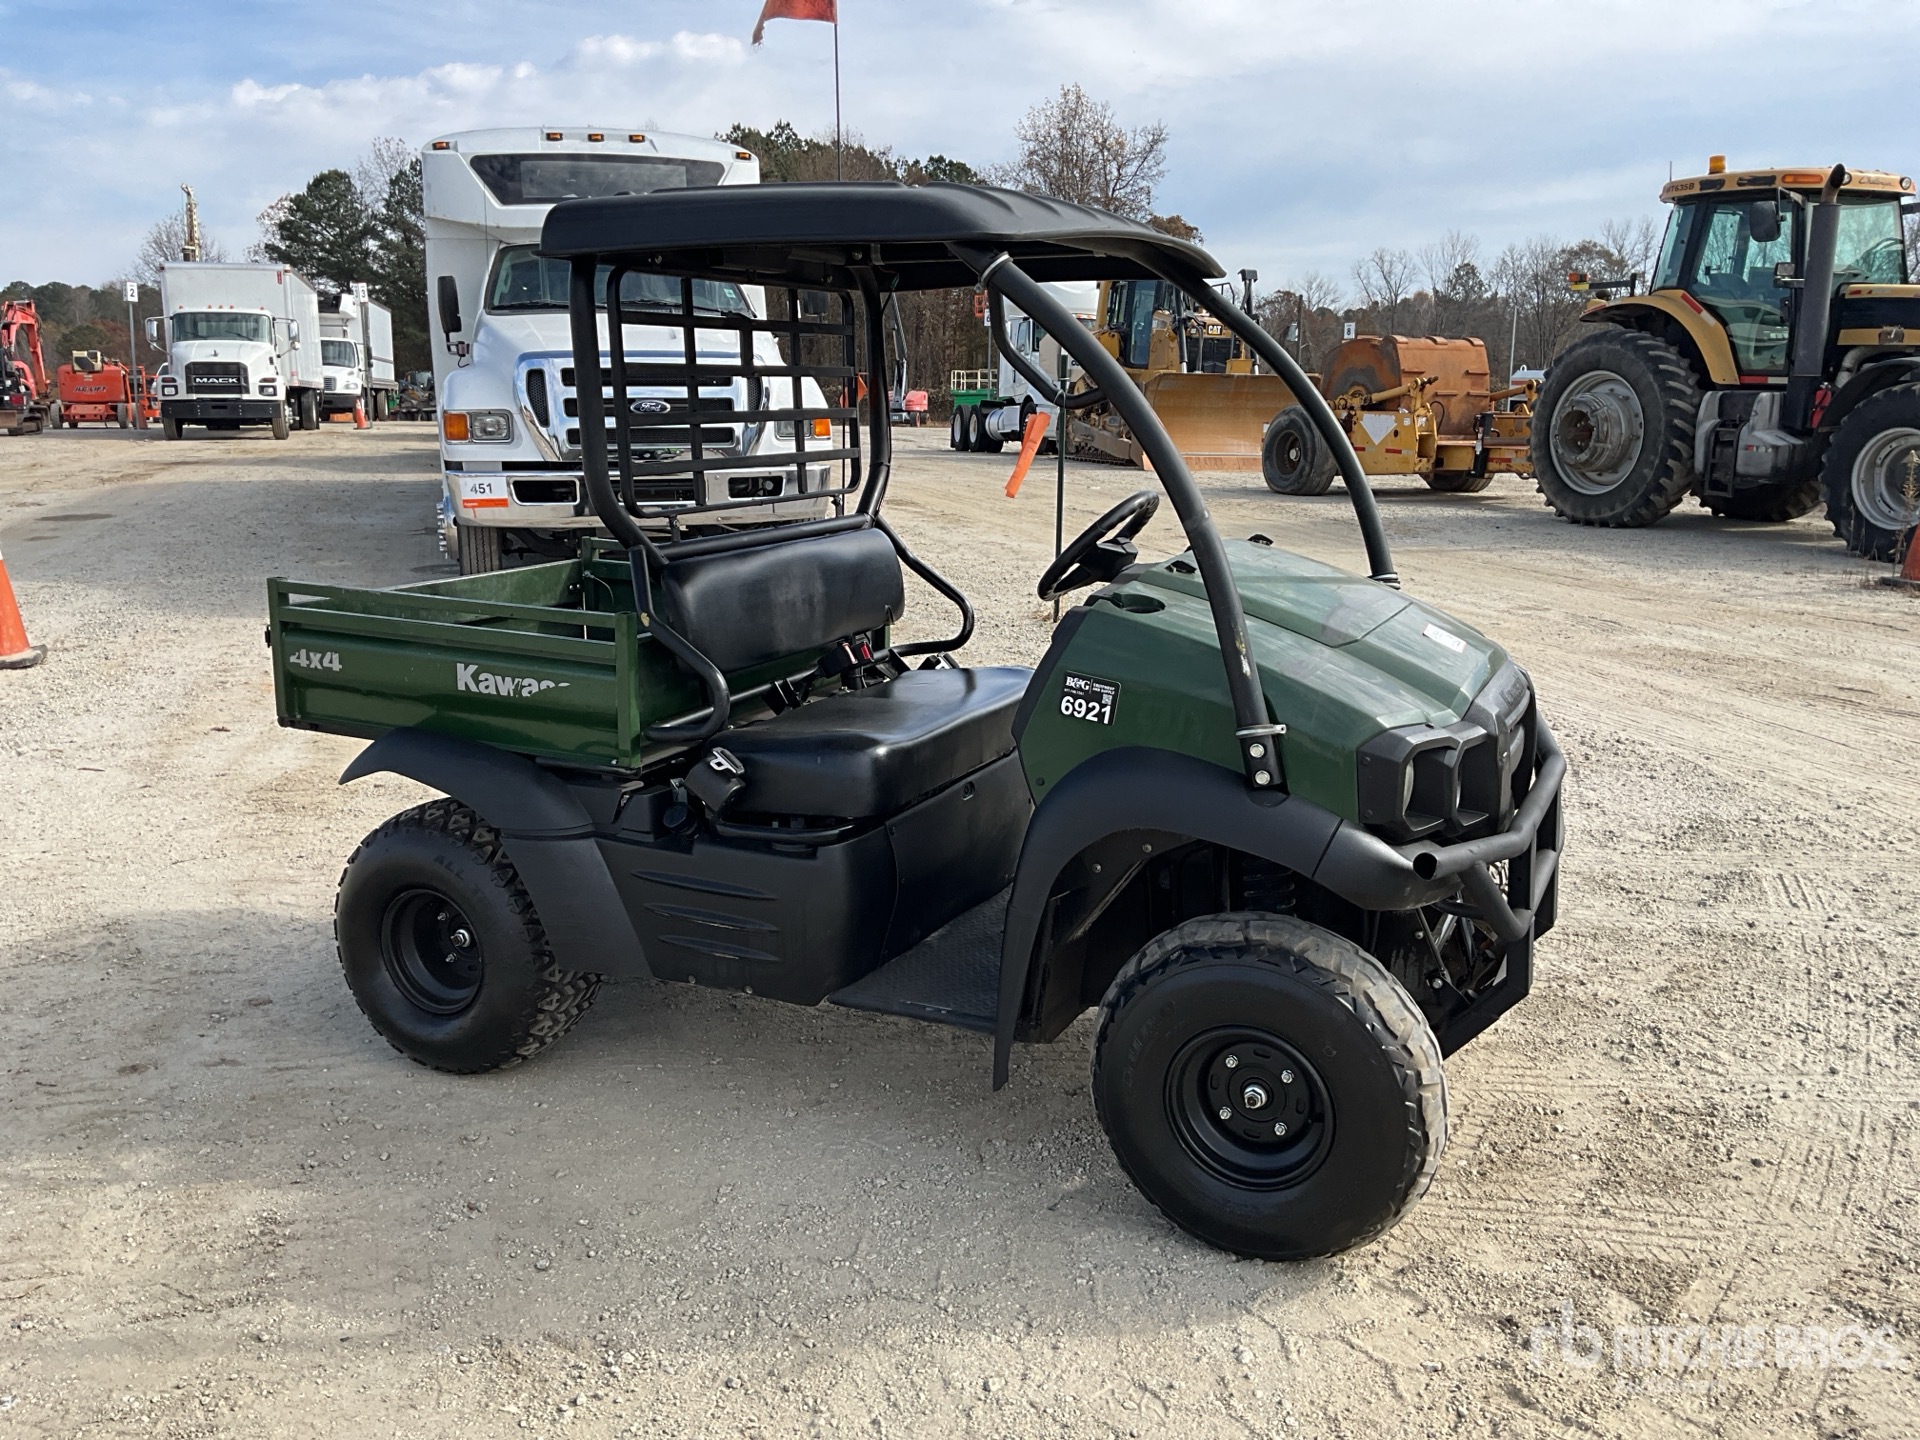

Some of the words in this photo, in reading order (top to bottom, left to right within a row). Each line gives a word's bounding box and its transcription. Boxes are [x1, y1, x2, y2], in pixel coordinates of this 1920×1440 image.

[129, 288, 136, 298] 2
[361, 289, 366, 298] 3
[1208, 325, 1222, 335] CAT
[639, 402, 662, 412] Ford
[470, 483, 493, 494] 451
[289, 649, 343, 672] 4x4
[1066, 676, 1090, 690] B&G
[1061, 696, 1112, 725] 6921
